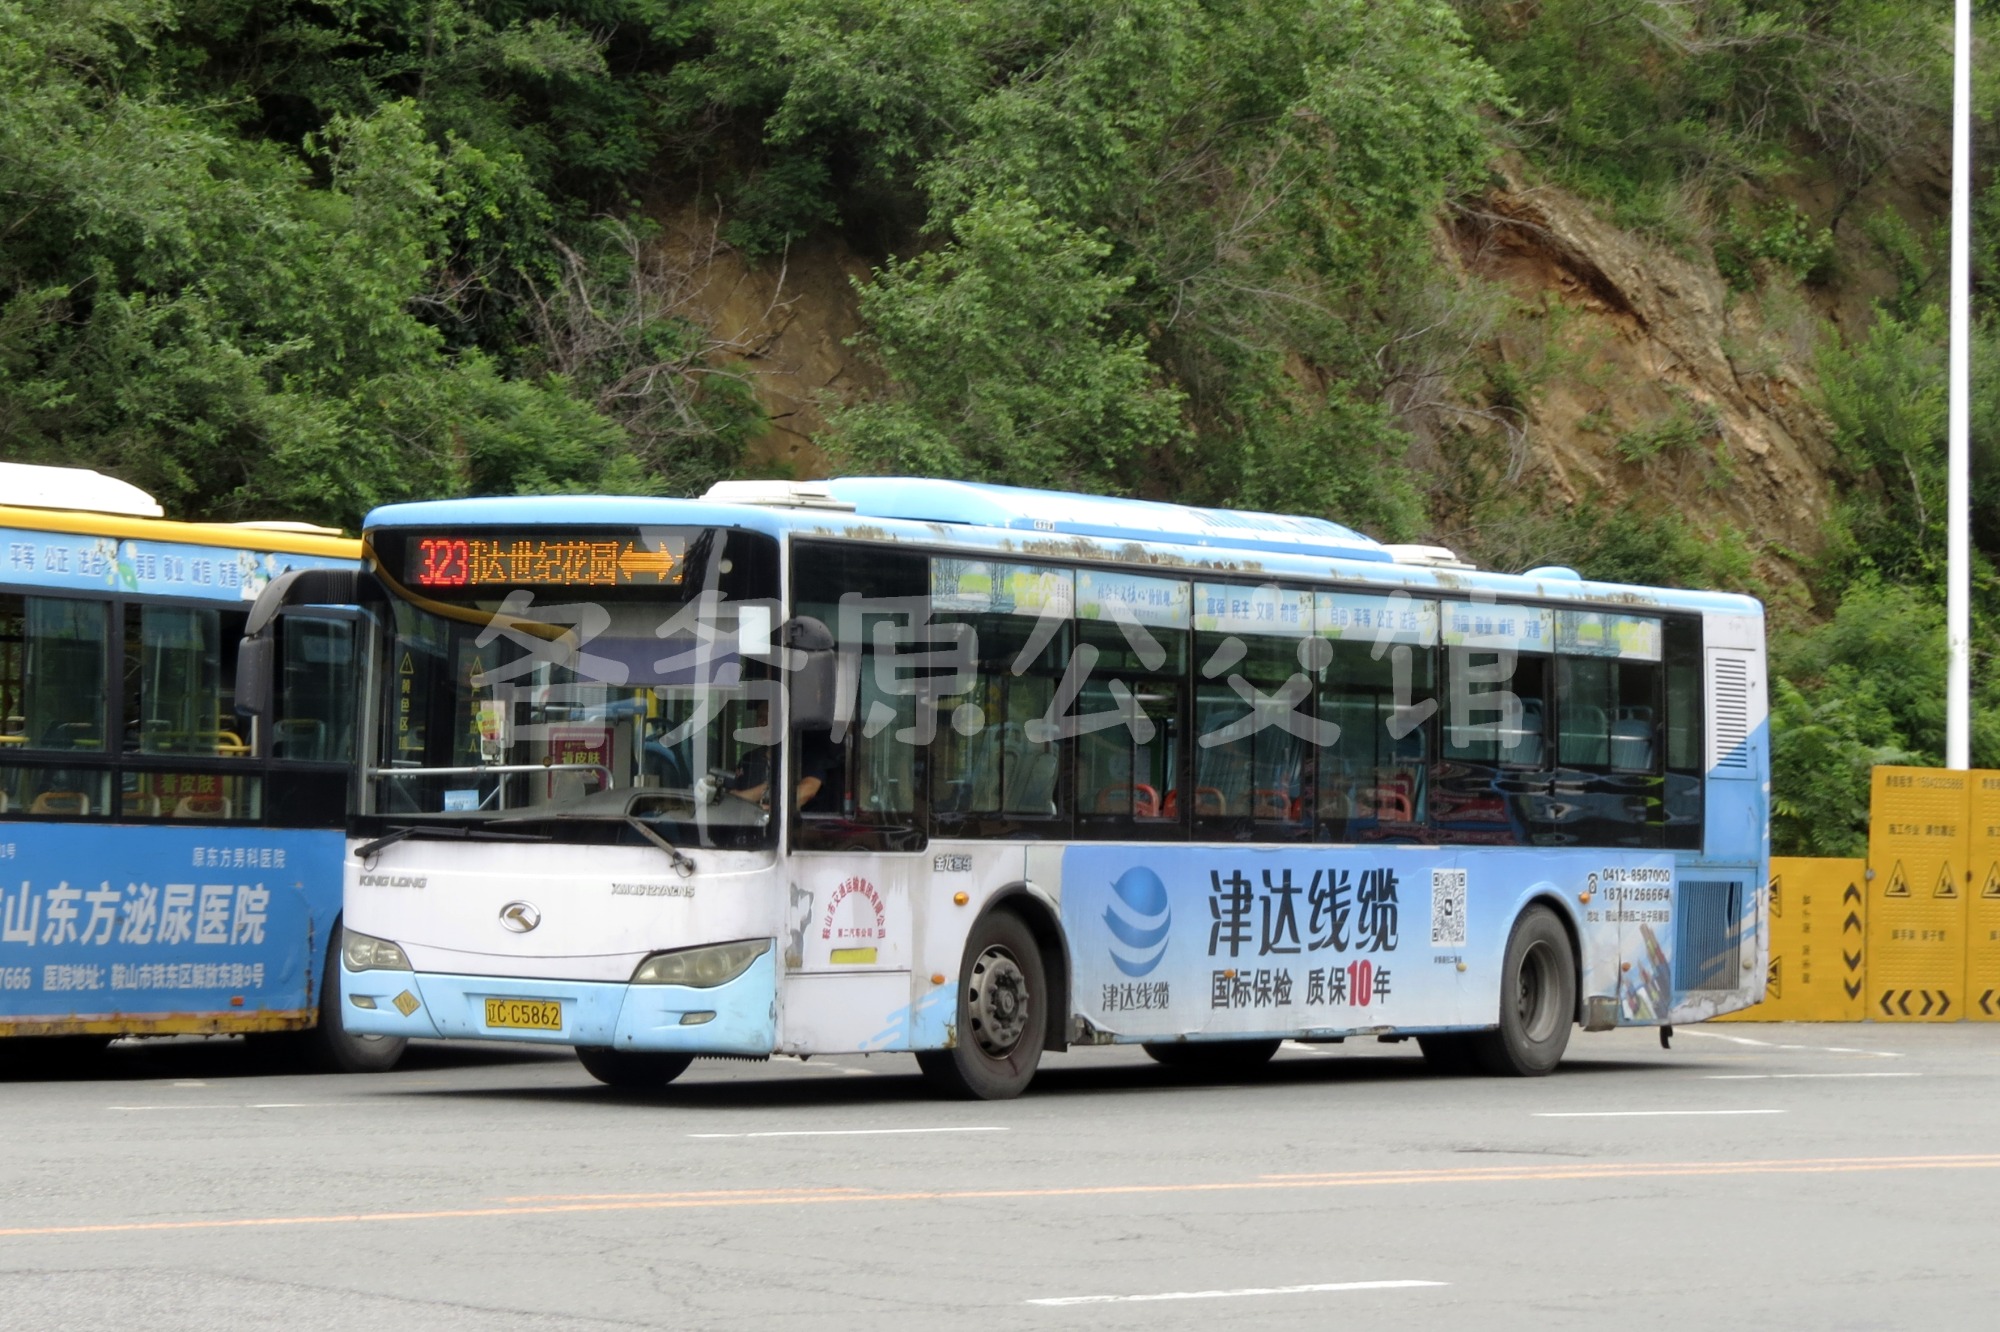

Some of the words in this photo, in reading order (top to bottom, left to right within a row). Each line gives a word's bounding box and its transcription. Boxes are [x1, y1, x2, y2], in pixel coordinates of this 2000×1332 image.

[10, 543, 35, 571] 平等
[45, 547, 68, 574] 公正
[78, 548, 103, 577] 法治
[136, 553, 156, 580] 爱国
[219, 559, 238, 587] 友善
[420, 540, 467, 584] 323
[1207, 597, 1225, 617] 富强
[1232, 599, 1249, 619] 民主
[1256, 602, 1274, 621] 文明
[1280, 603, 1298, 623] 和谐
[1330, 607, 1348, 625] 自由
[1354, 608, 1371, 628] 平等
[1377, 609, 1394, 629] 公正
[192, 847, 286, 868] 原东方男科医院
[934, 856, 972, 872] 金龙客车
[359, 875, 390, 887] KING
[391, 876, 427, 889] LONG
[0, 880, 270, 946] 山东方泌尿医院
[1207, 867, 1400, 958] 津达线缆
[1102, 981, 1169, 1012] 津达线缆
[1211, 967, 1293, 1010] 国标保检
[1306, 959, 1391, 1007] 质保10年
